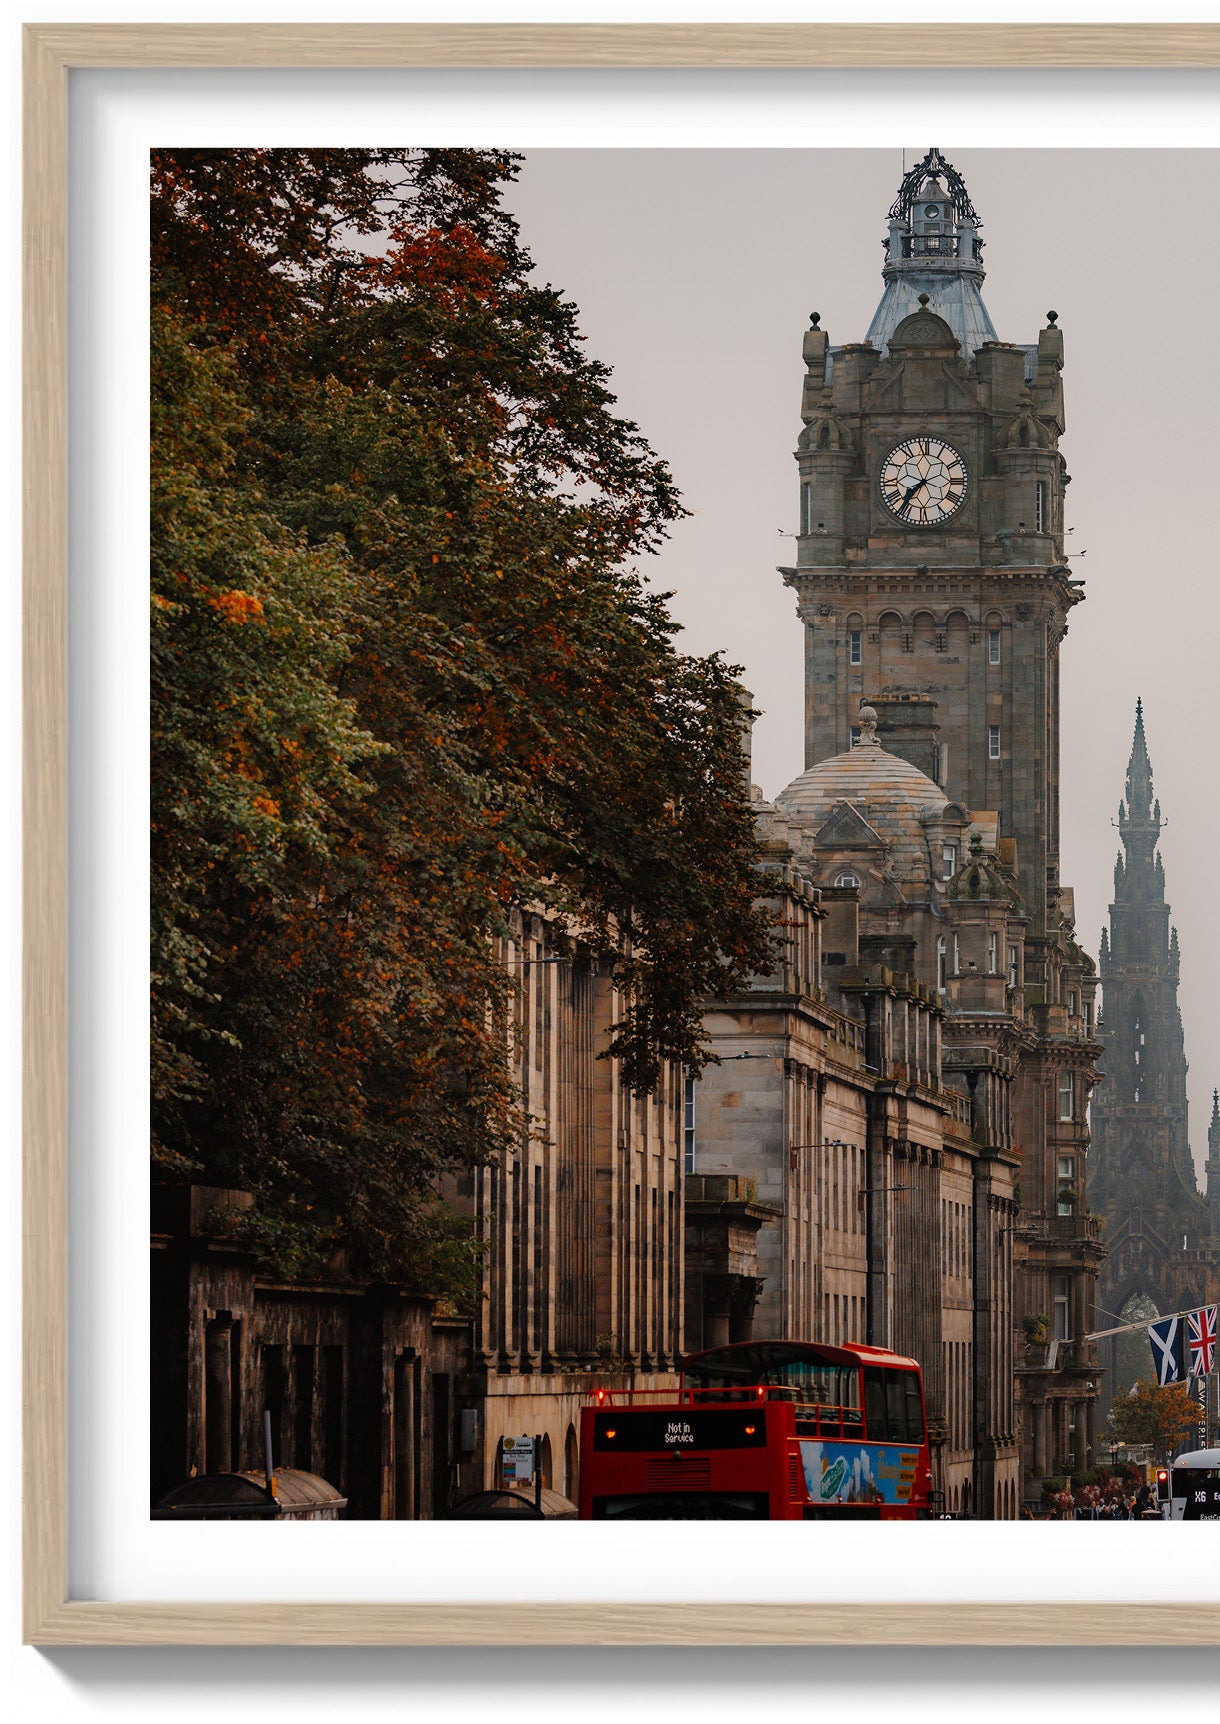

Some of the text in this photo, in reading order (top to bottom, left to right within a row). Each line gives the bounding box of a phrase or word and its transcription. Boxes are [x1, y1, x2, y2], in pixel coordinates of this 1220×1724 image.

[668, 1422, 690, 1433] Not in
[664, 1433, 694, 1443] Service
[1195, 1491, 1206, 1502] X6
